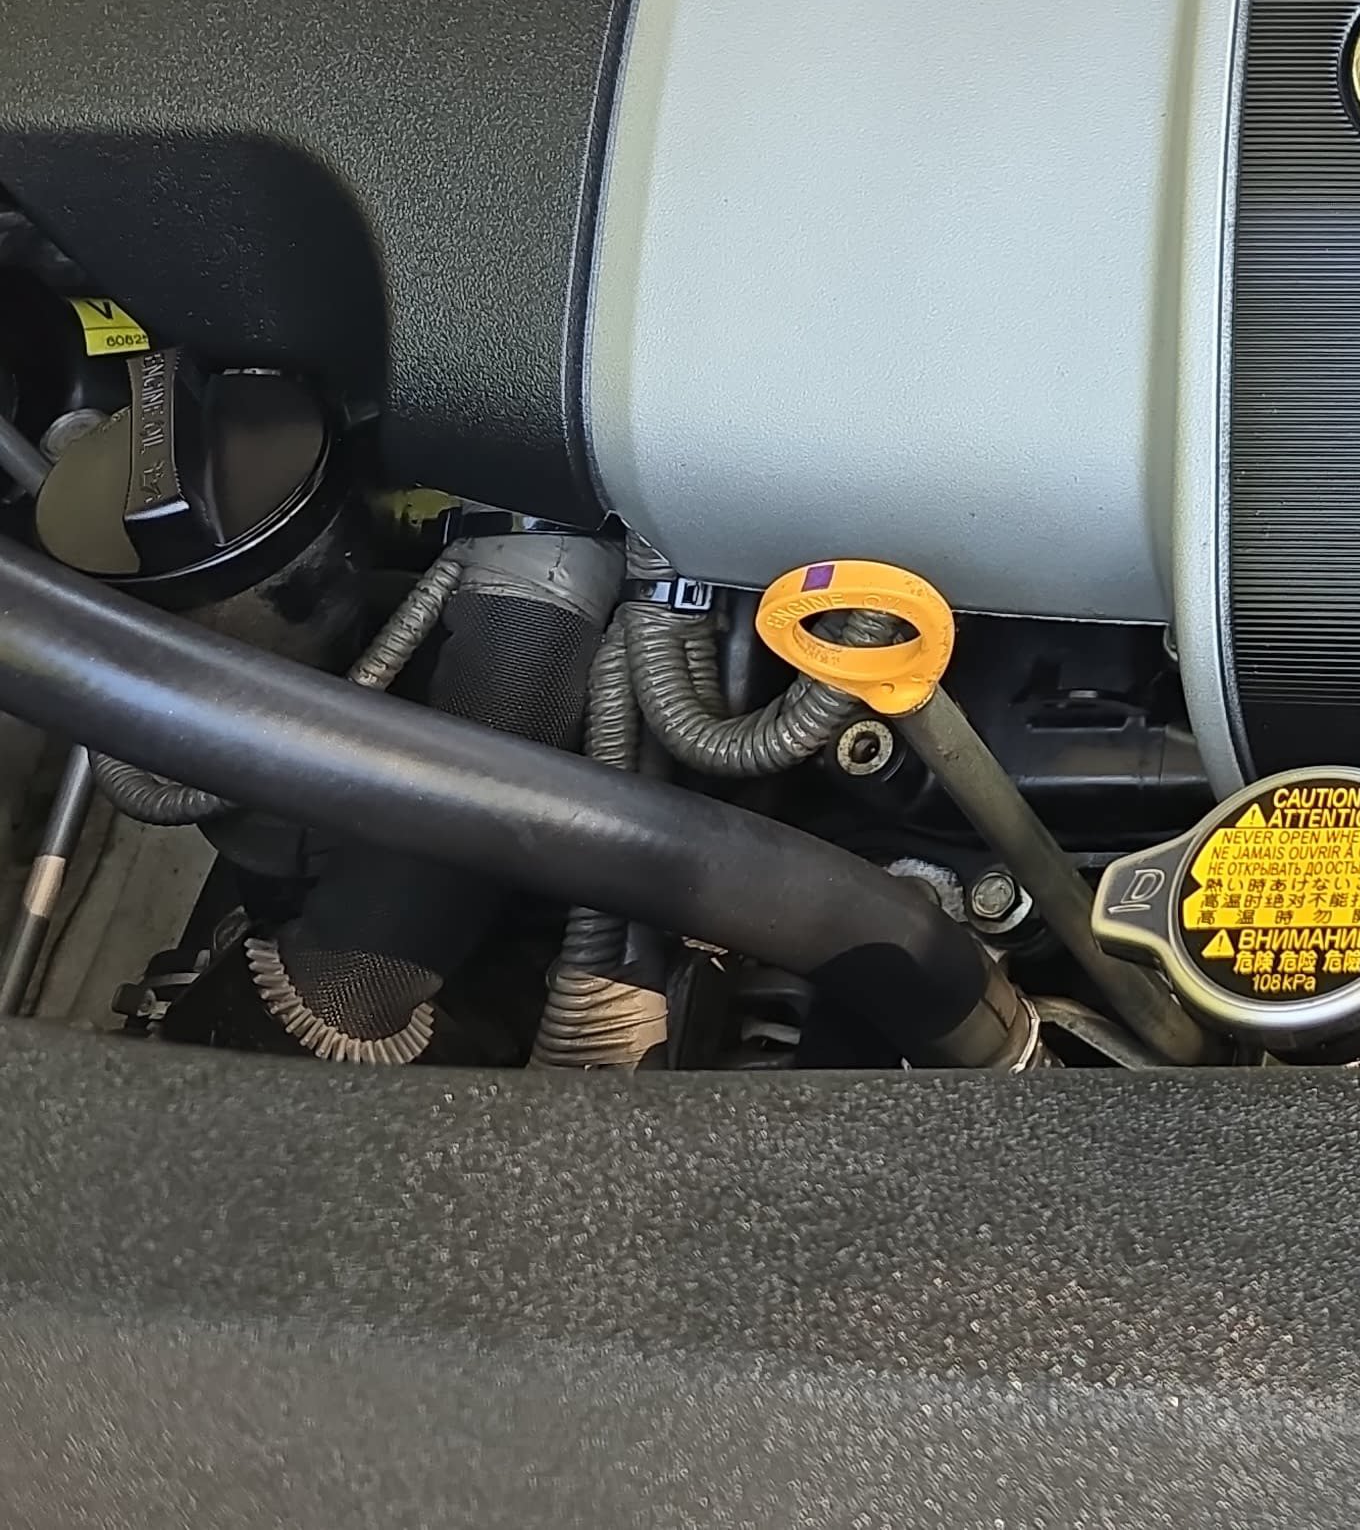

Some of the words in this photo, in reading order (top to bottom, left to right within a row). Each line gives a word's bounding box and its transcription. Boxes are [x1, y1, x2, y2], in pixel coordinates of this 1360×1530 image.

[85, 301, 114, 320] V
[765, 593, 849, 629] ENGINE
[1221, 831, 1274, 845] NEVER
[1279, 830, 1321, 844] OPEN
[1211, 846, 1230, 860] NE
[1232, 845, 1285, 860] JAMAIS
[1289, 845, 1341, 860] OUVRIR
[1344, 843, 1355, 859] À
